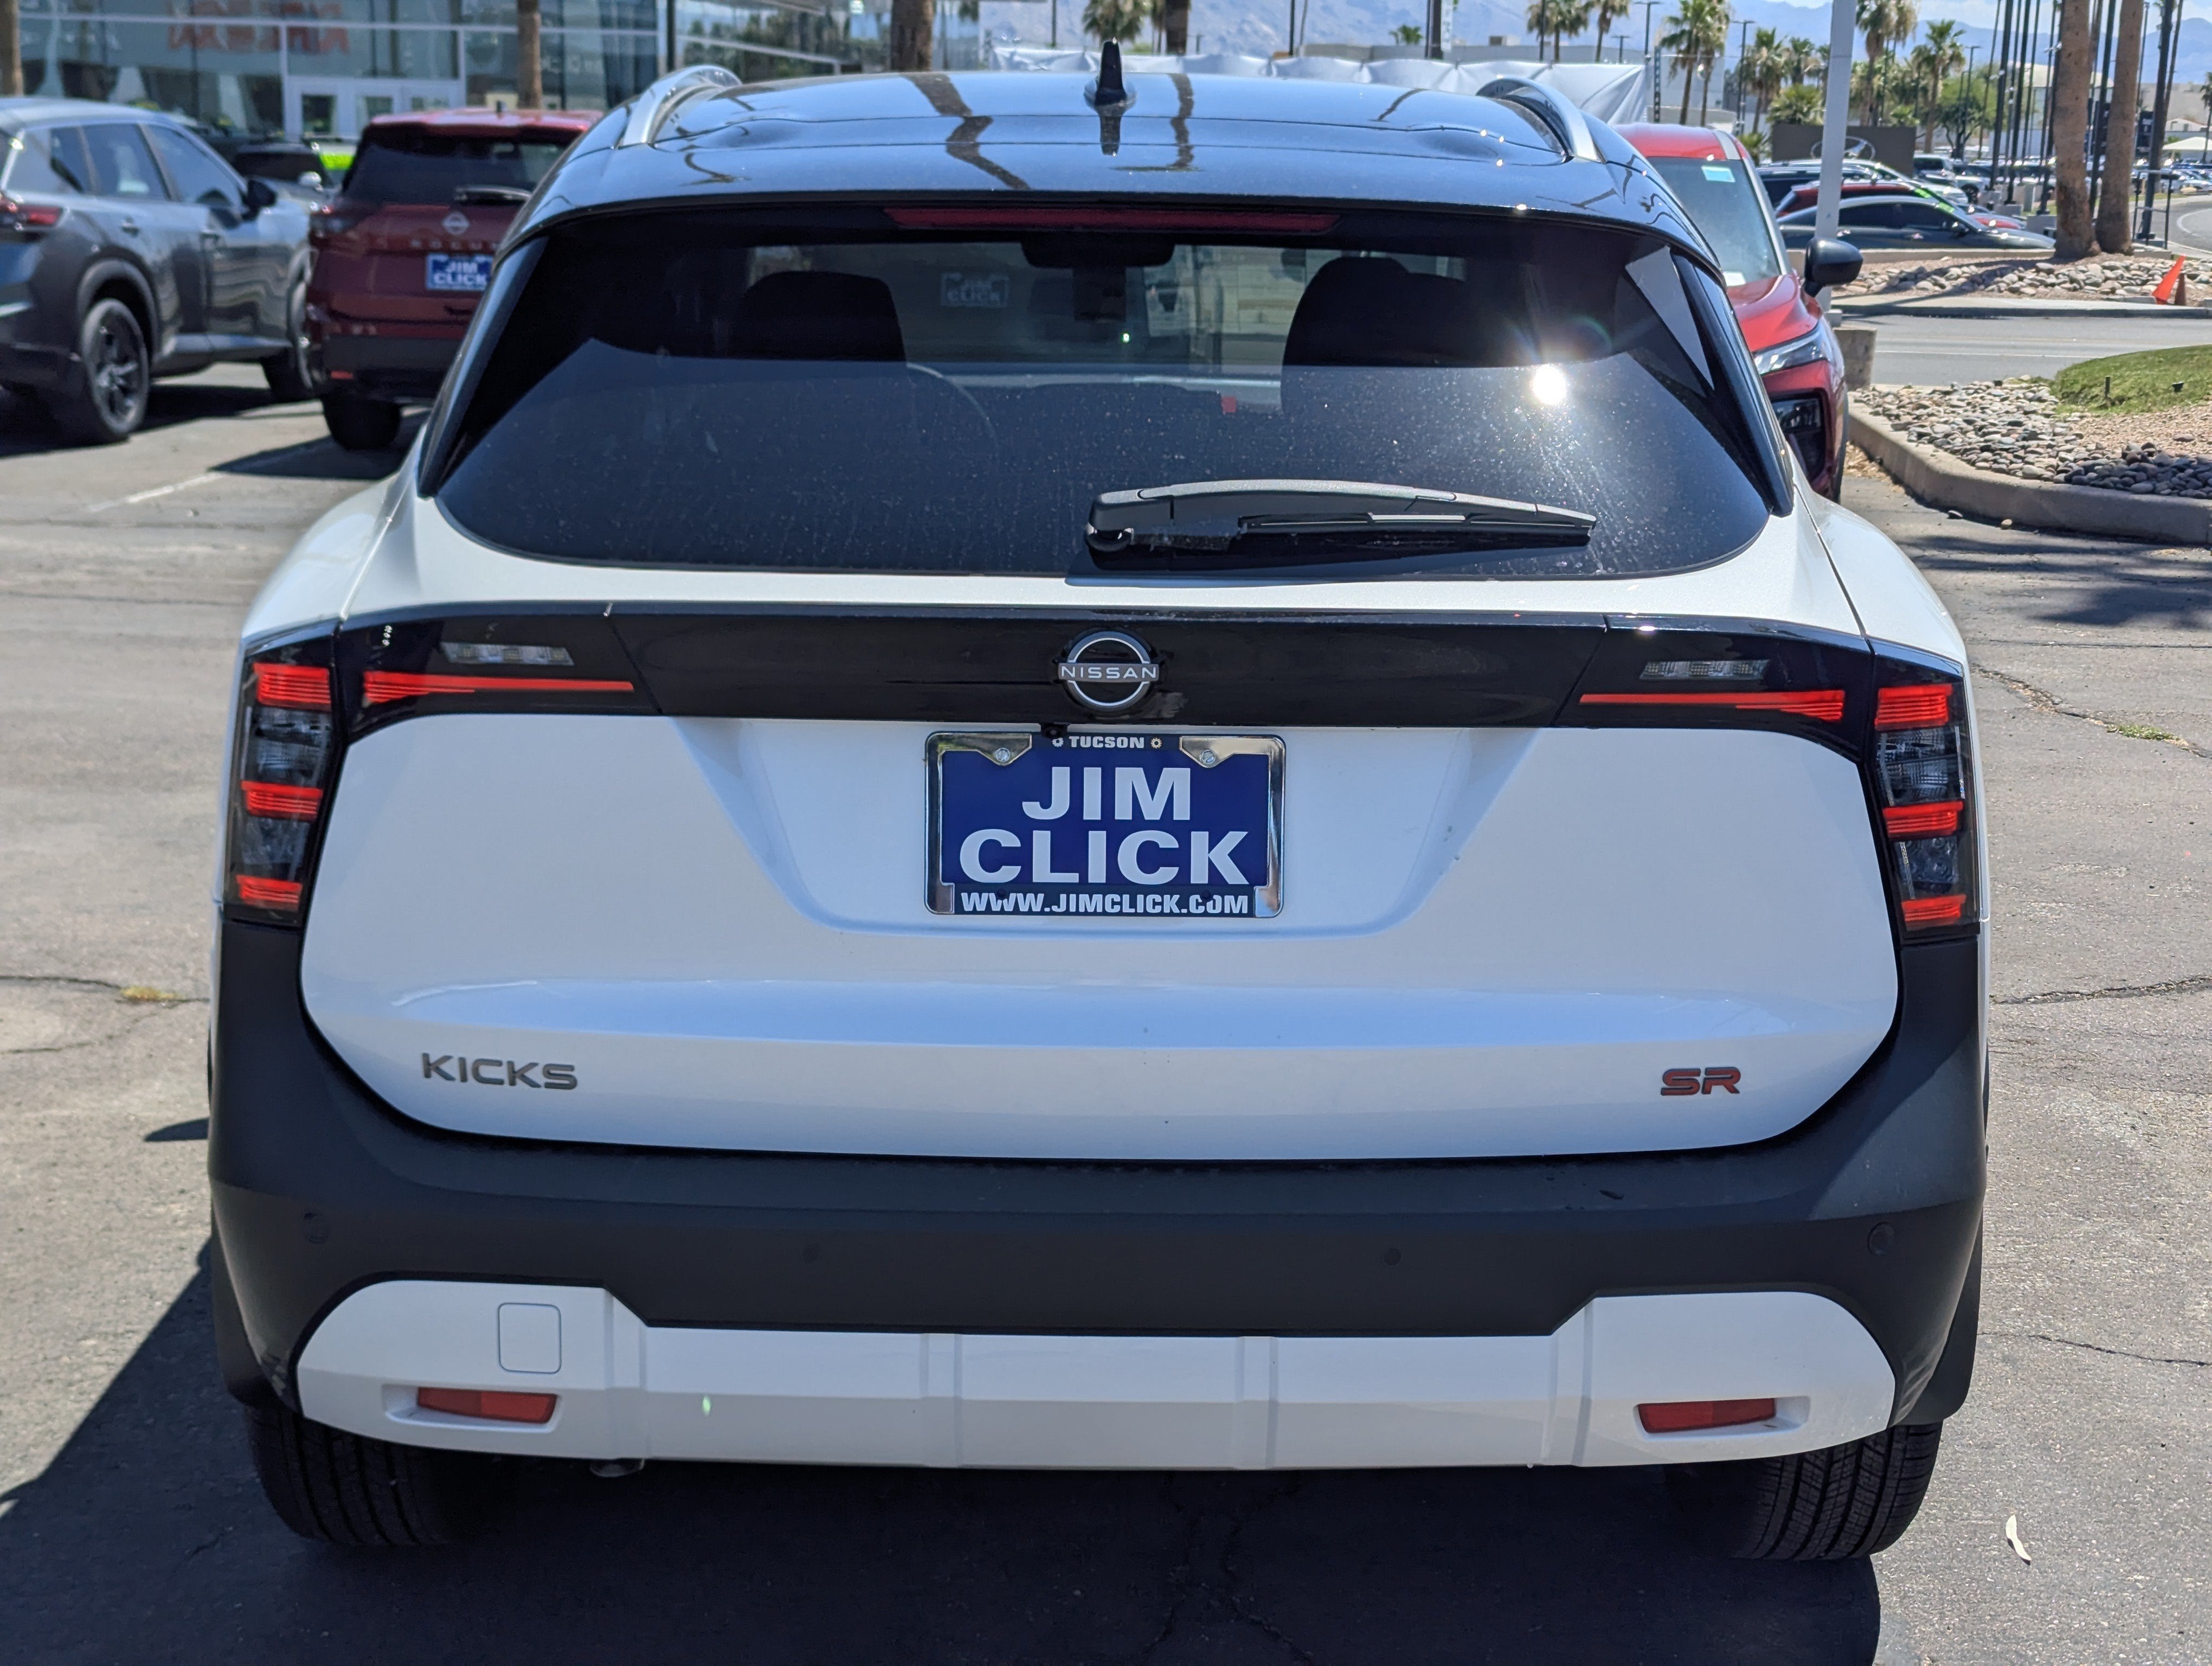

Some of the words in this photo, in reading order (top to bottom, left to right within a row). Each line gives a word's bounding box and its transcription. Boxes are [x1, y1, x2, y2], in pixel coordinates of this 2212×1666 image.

[446, 262, 478, 273] JIM
[434, 273, 486, 285] CLICK
[1060, 665, 1156, 679] NISSAN
[1069, 735, 1144, 749] TUCSON
[1022, 766, 1191, 821] JIM
[959, 829, 1250, 885] CLICK
[961, 892, 1249, 914] WWW.JIMCLICK.COM
[422, 1052, 578, 1090] KICKS
[1660, 1066, 1741, 1096] SR
